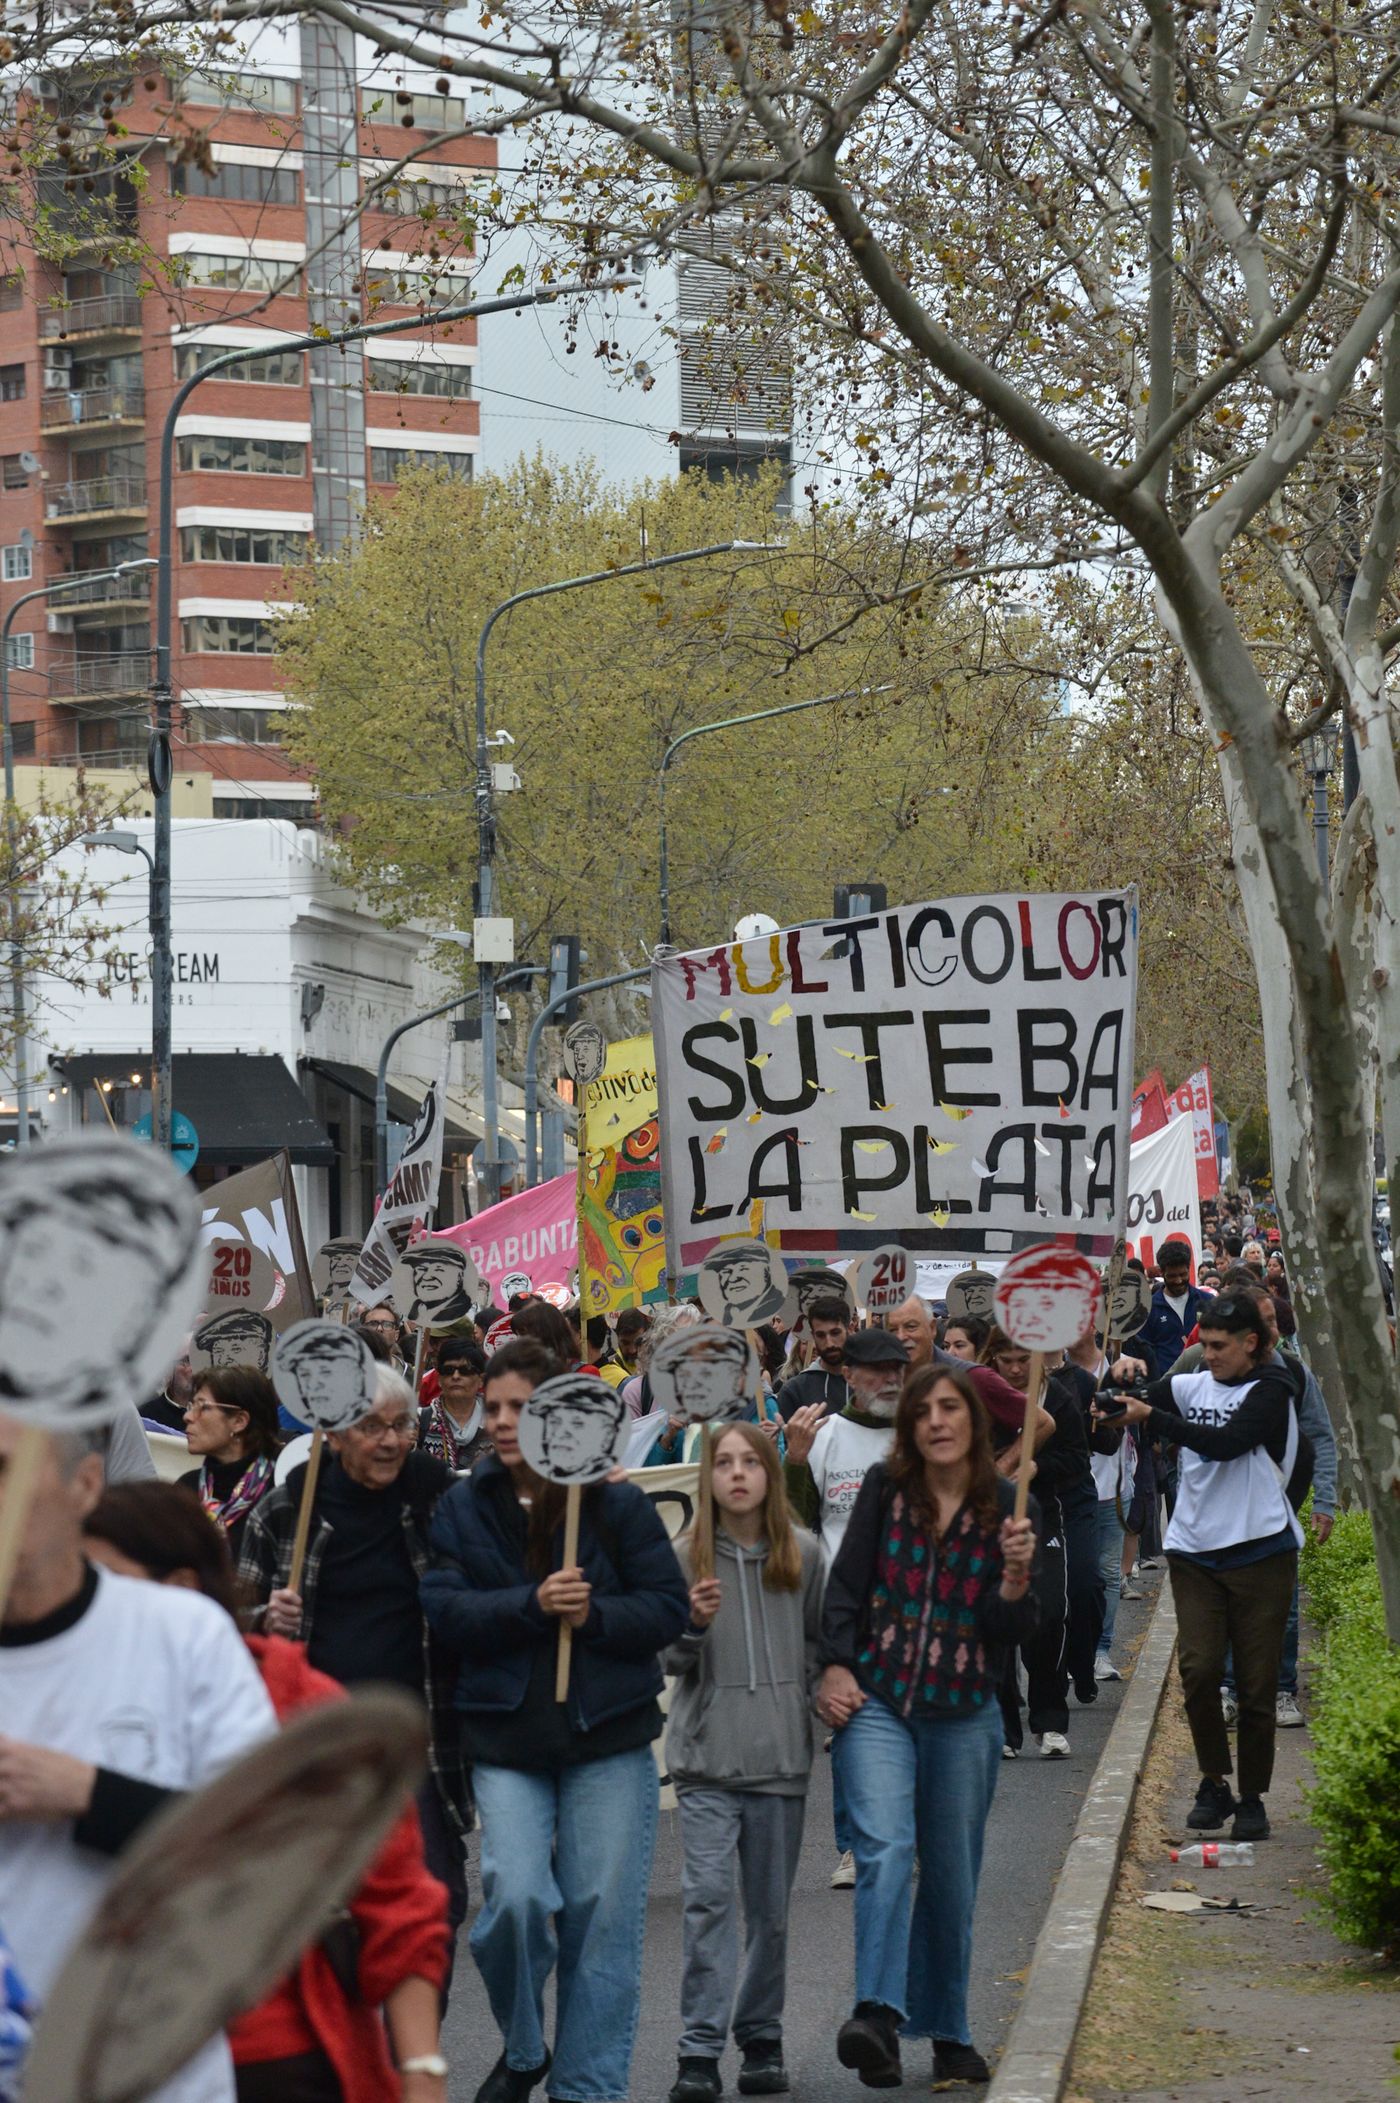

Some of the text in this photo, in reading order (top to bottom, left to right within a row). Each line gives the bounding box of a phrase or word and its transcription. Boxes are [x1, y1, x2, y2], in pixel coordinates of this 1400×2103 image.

[680, 898, 1127, 1000] MULTICOLOR
[148, 953, 219, 982] EAM
[682, 1008, 1125, 1122] SUTEBA
[688, 1124, 1116, 1224] LA PLATA
[1166, 1204, 1190, 1222] del
[213, 1246, 251, 1277] 20
[871, 1251, 906, 1287] 20
